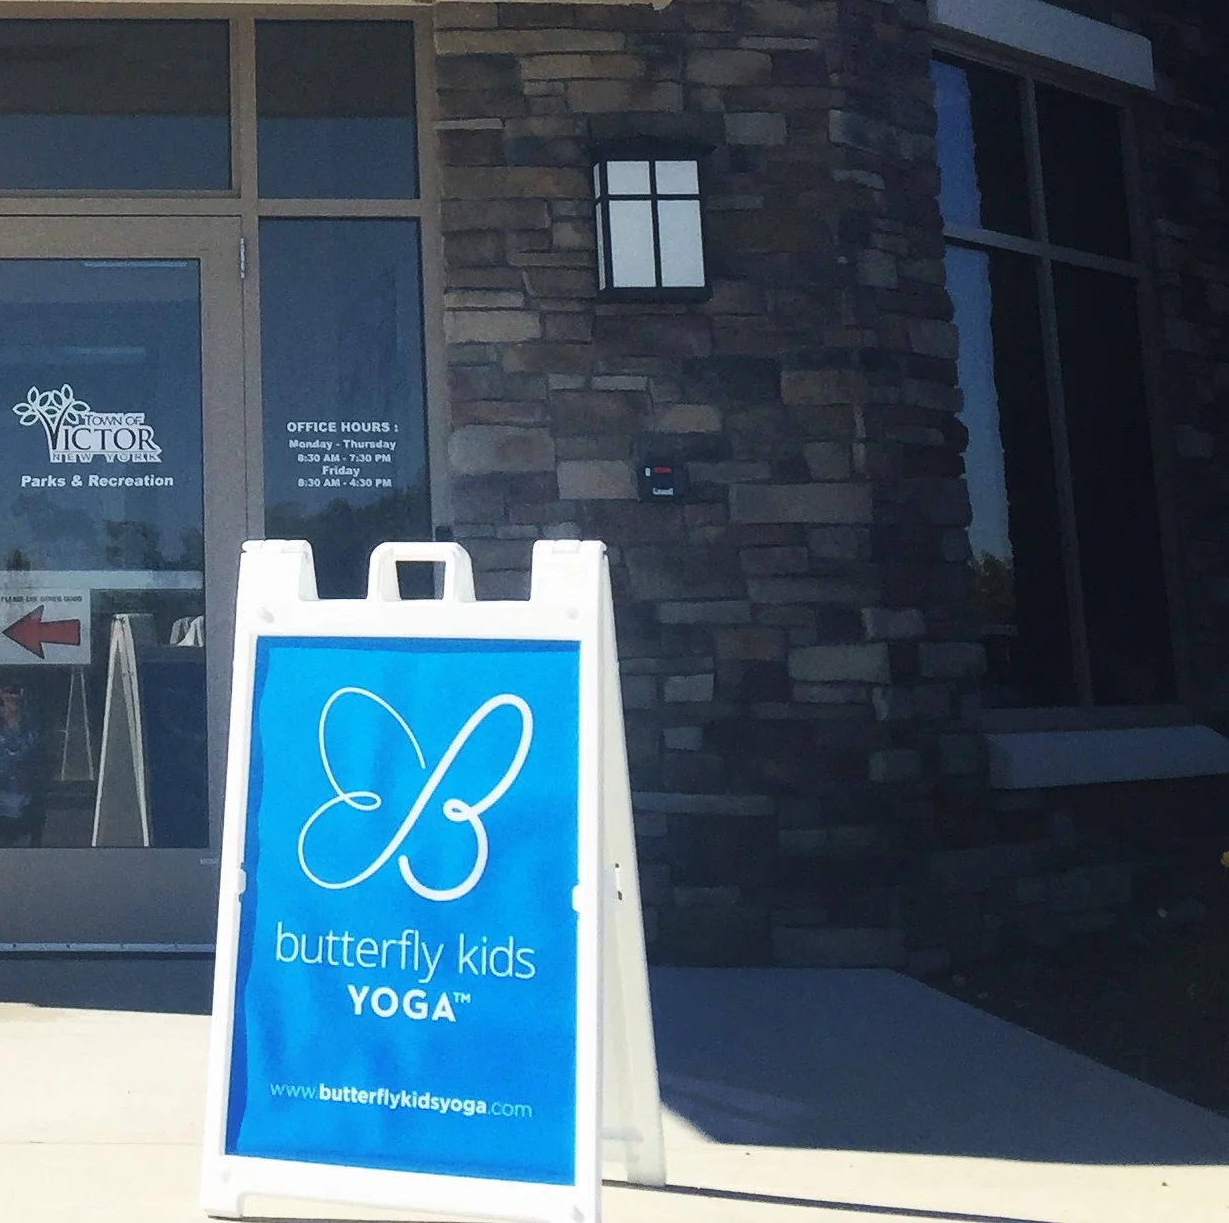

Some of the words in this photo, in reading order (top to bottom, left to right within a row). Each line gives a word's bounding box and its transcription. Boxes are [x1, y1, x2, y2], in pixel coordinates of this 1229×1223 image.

[85, 414, 122, 426] TOWN
[126, 414, 143, 426] OF
[286, 421, 337, 433] OFFICE
[341, 421, 390, 433] HOURS
[288, 439, 333, 451] Monday
[343, 439, 396, 451] Thursday
[52, 453, 91, 461] NEW
[107, 453, 158, 461] YORK
[297, 454, 321, 463] 8:30
[323, 454, 340, 463] AM
[349, 454, 372, 463] 7:30
[375, 454, 391, 462] PM
[322, 466, 360, 477] Friday
[21, 475, 66, 487] Parks
[71, 475, 83, 487] &
[88, 474, 174, 487] Recreation
[297, 478, 321, 488] 8:30
[323, 478, 340, 488] AM
[349, 478, 372, 488] 4:30
[375, 479, 392, 488] PM
[275, 921, 444, 984] butterfly
[458, 933, 537, 980] kids
[270, 1082, 533, 1118] www.butterflykidsyoga.com
